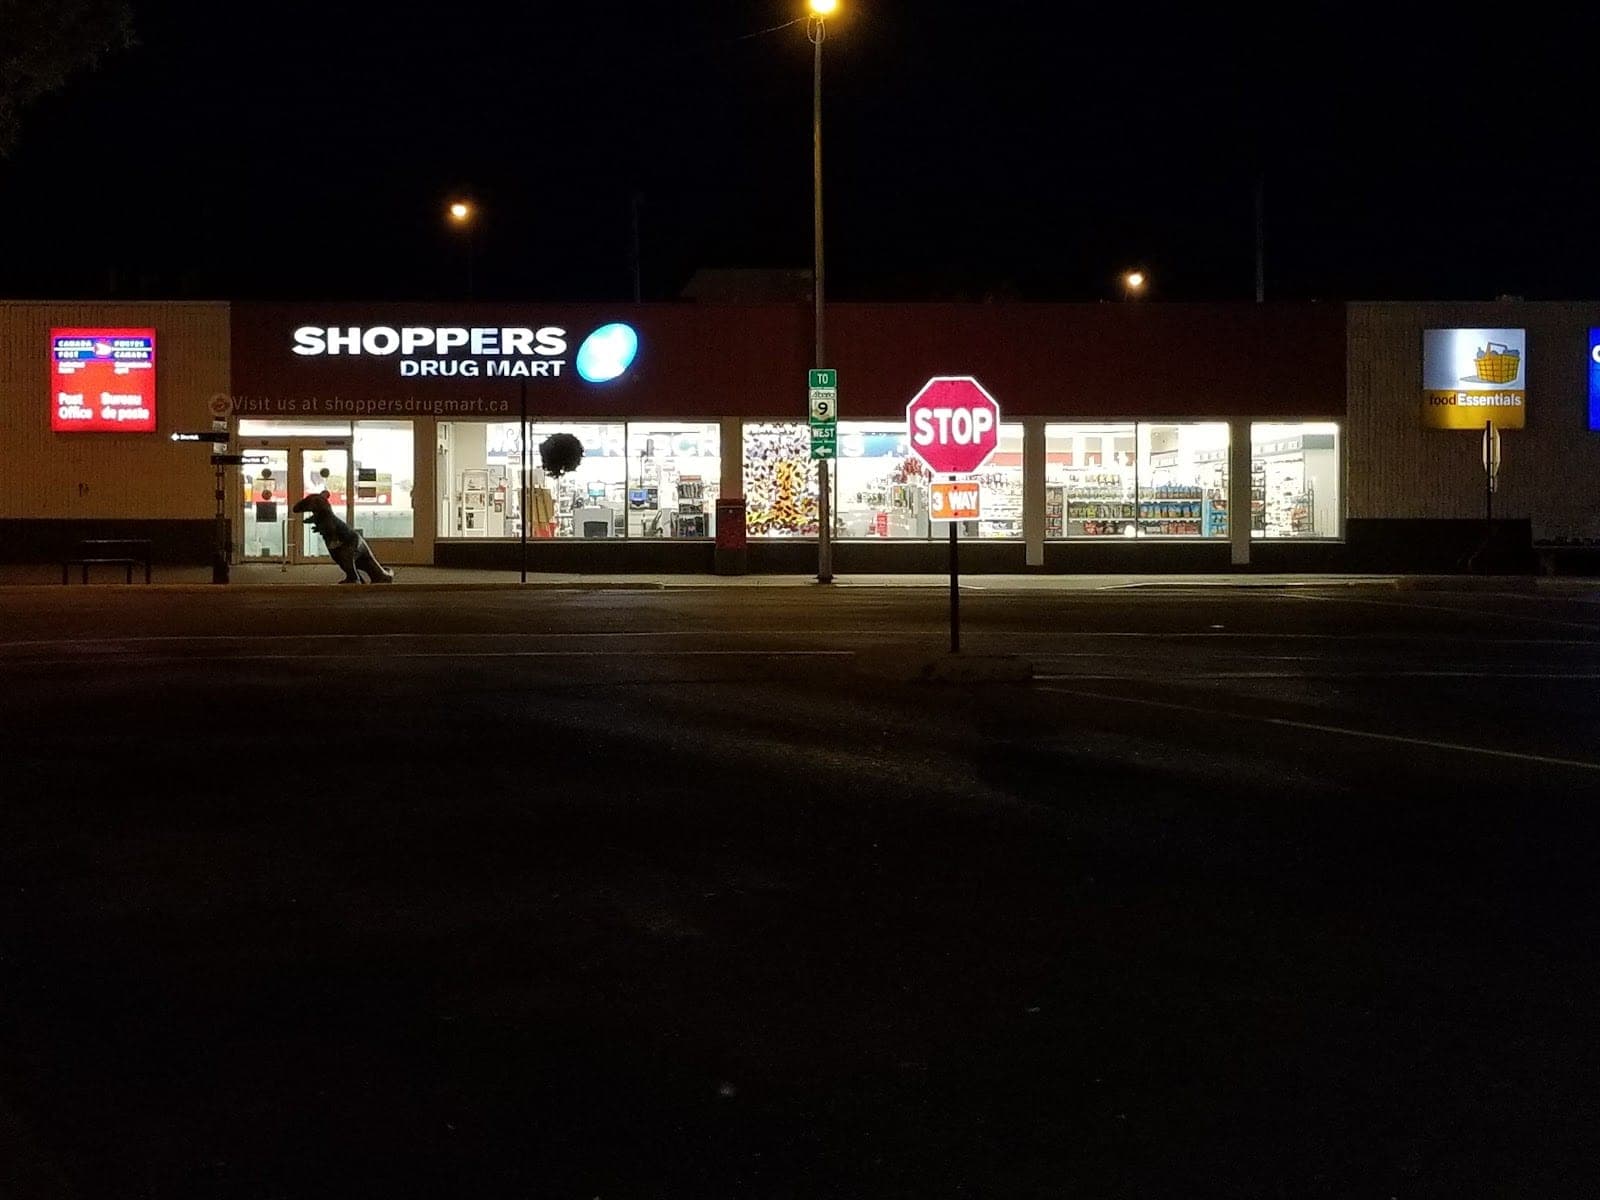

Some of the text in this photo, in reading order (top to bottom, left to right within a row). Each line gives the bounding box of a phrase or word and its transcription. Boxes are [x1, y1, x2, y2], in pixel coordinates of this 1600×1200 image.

[292, 326, 567, 356] SHOPPERS
[400, 359, 567, 377] DRUG MART
[816, 372, 829, 385] TO
[58, 392, 83, 405] Post
[231, 397, 509, 414] Visit us at shoppersdrugmart.ca
[58, 406, 93, 419] Office
[101, 406, 117, 419] de
[817, 401, 829, 416] 9
[812, 428, 835, 438] WEST
[914, 407, 993, 446] STOP
[932, 491, 978, 511] 3 WAY
